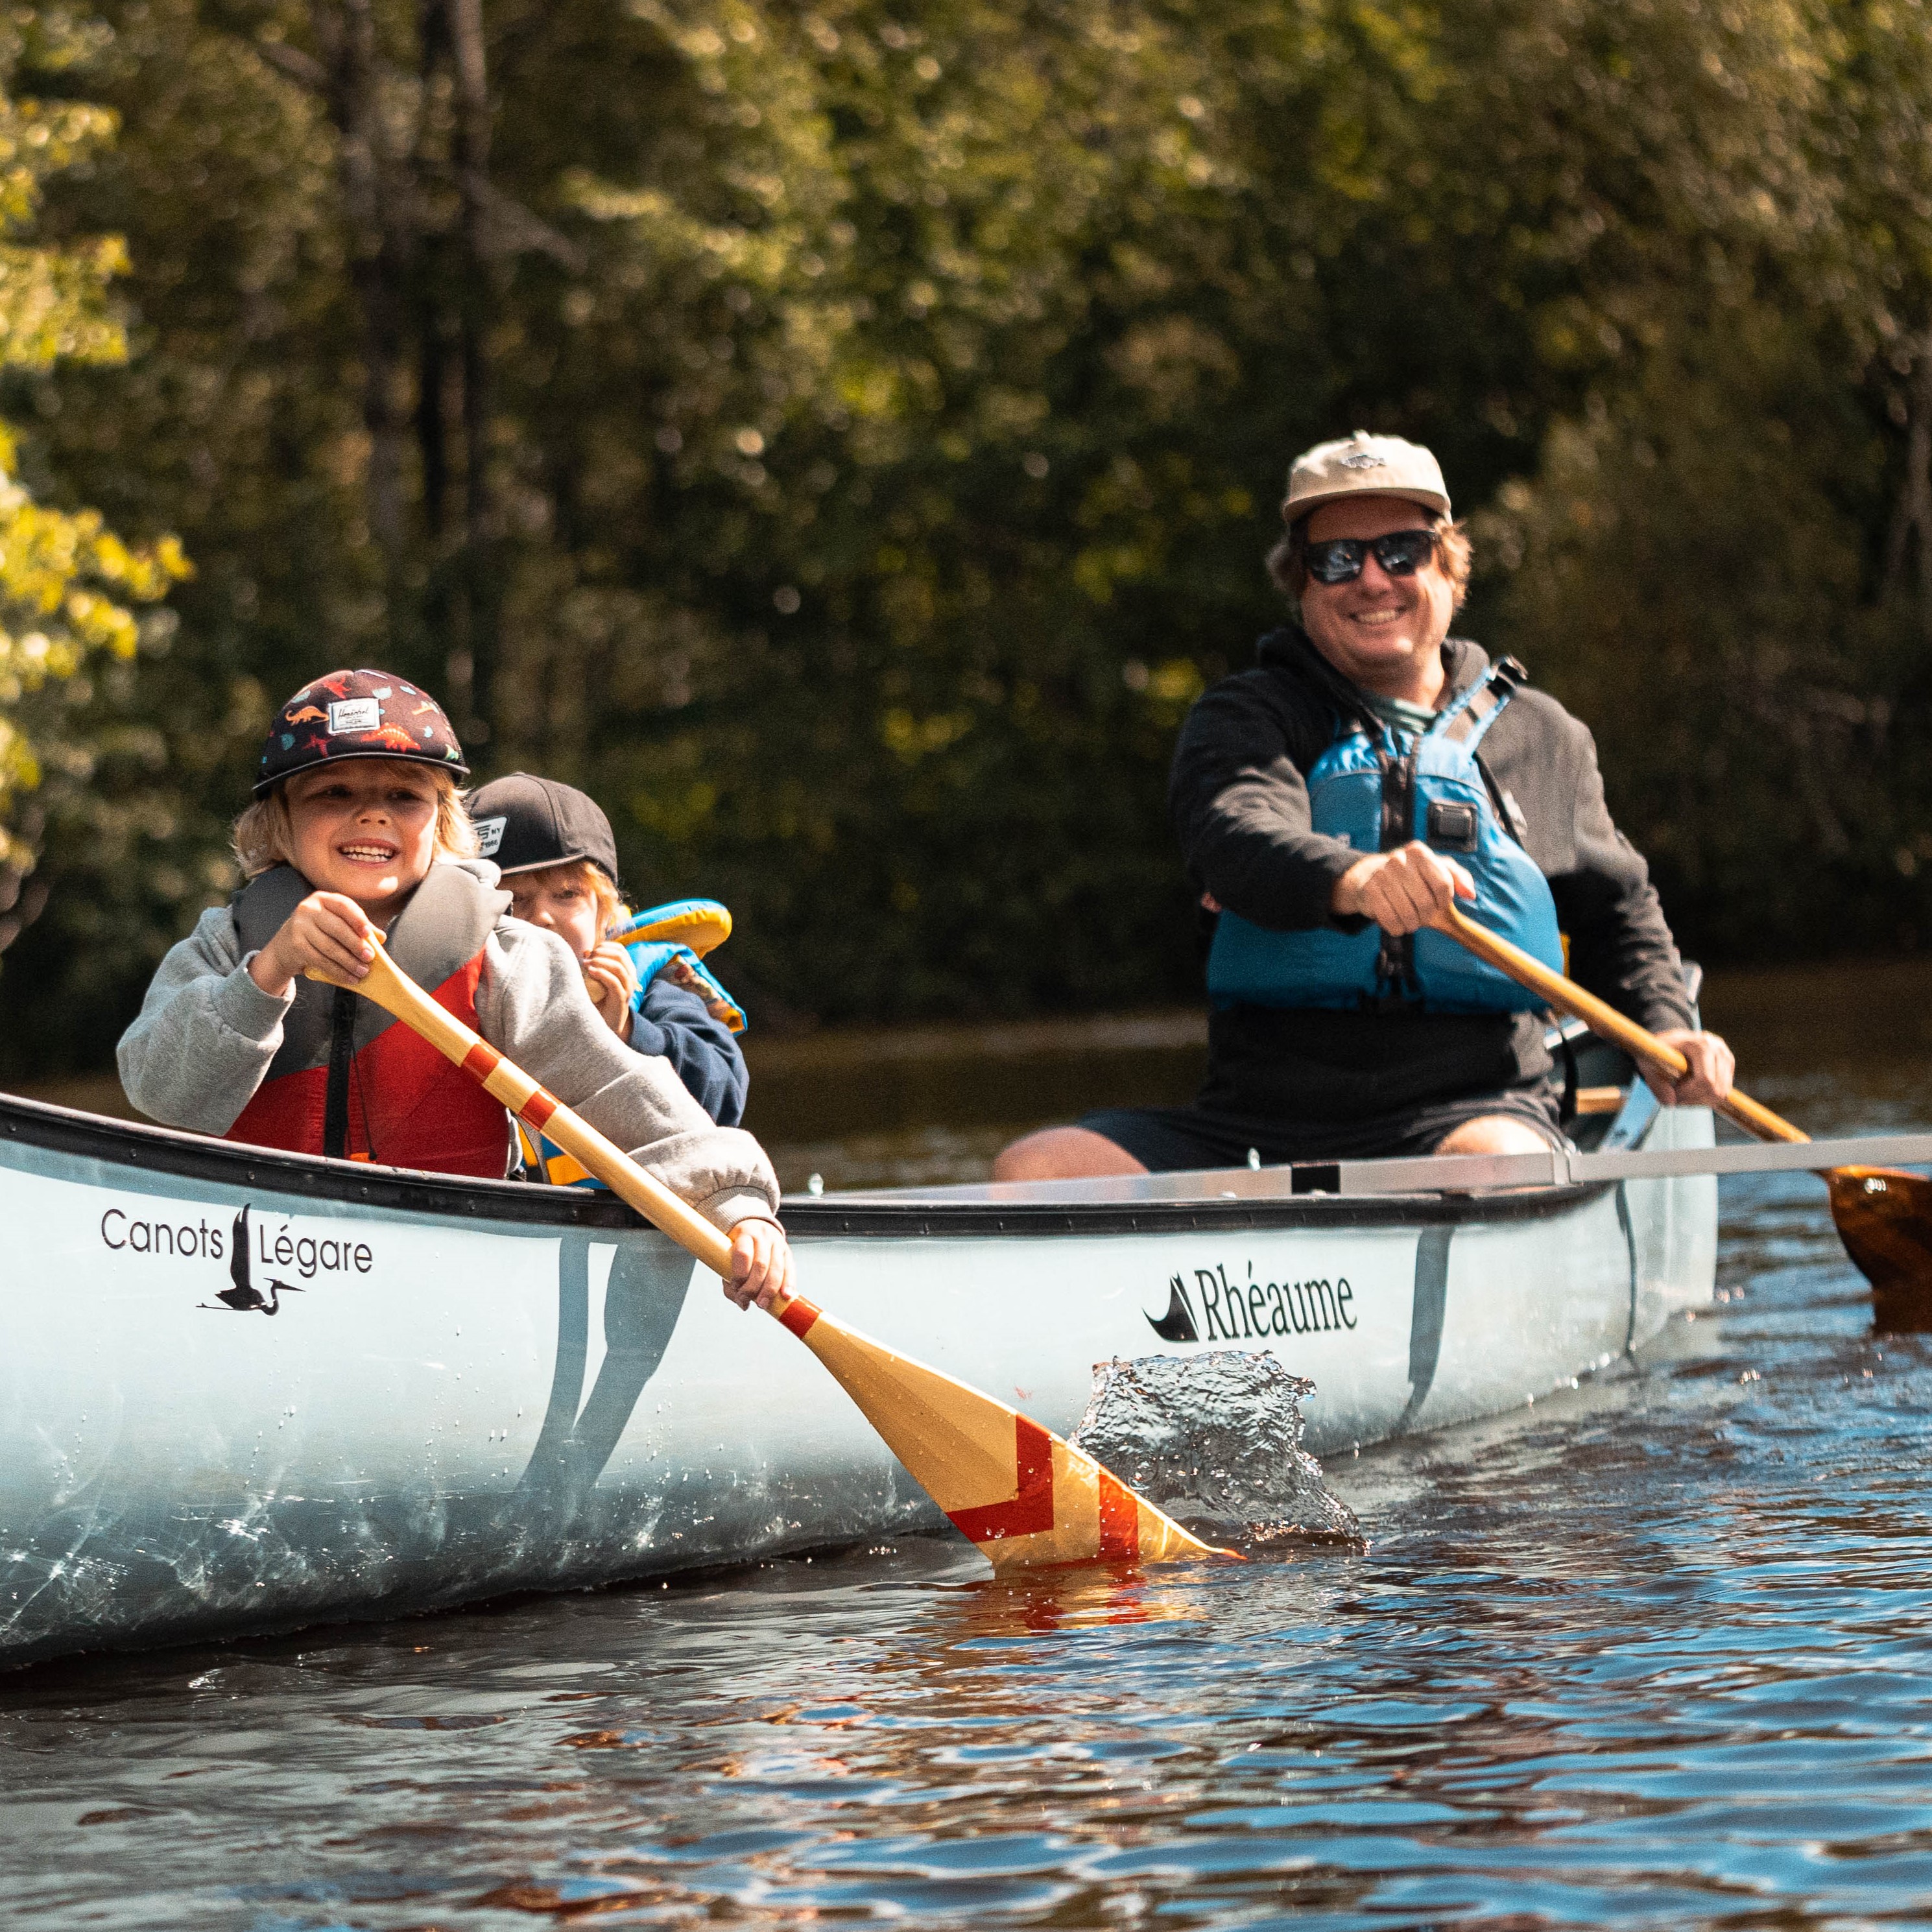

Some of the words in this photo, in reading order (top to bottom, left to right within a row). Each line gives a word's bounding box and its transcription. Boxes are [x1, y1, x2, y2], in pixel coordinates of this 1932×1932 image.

[101, 1208, 223, 1260] Canots
[259, 1224, 372, 1278] Légare
[1194, 1260, 1357, 1342] Rhéaume
